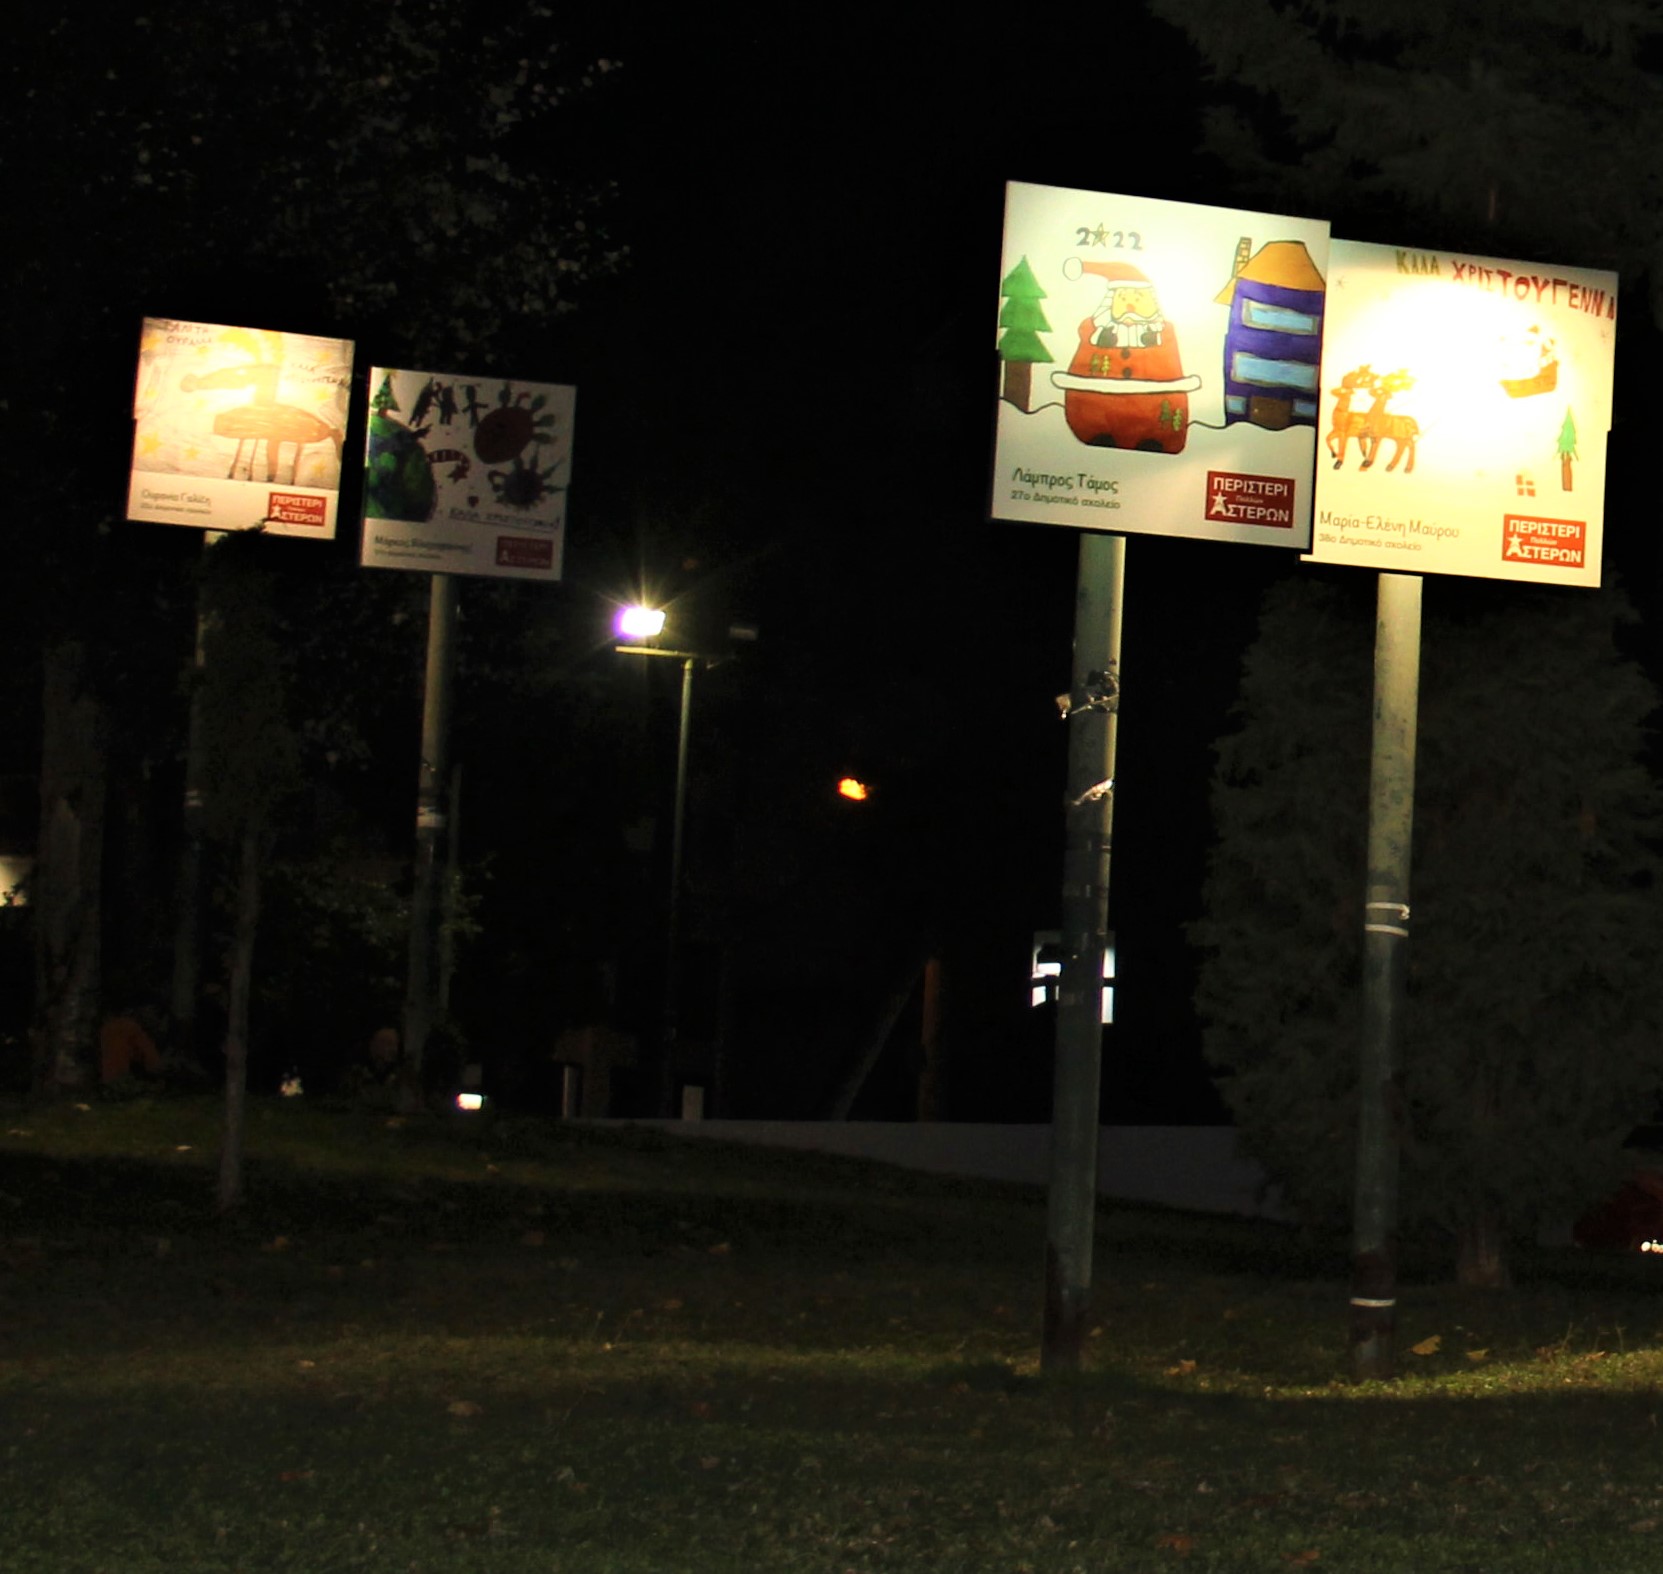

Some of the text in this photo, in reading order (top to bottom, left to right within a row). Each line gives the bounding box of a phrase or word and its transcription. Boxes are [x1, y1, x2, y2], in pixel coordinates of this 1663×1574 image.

[1075, 222, 1143, 251] 222
[1451, 260, 1615, 321] ΧΡΙΣΤΟΥΓΕΝΝΑ
[1012, 467, 1119, 494] Λάμπρος Τάμος
[1212, 477, 1288, 497] ΠΕΡΙΣΤΕΡΙ
[1210, 494, 1290, 522] ΑΣΤΕΡΩΝ
[1319, 511, 1460, 540] Μαρία-Ελένη Μαύρου
[1508, 519, 1581, 539] ΠΕΡΙΣΤΕΡΙ
[1506, 535, 1582, 563] ΑΣΤΕΡΩΝ
